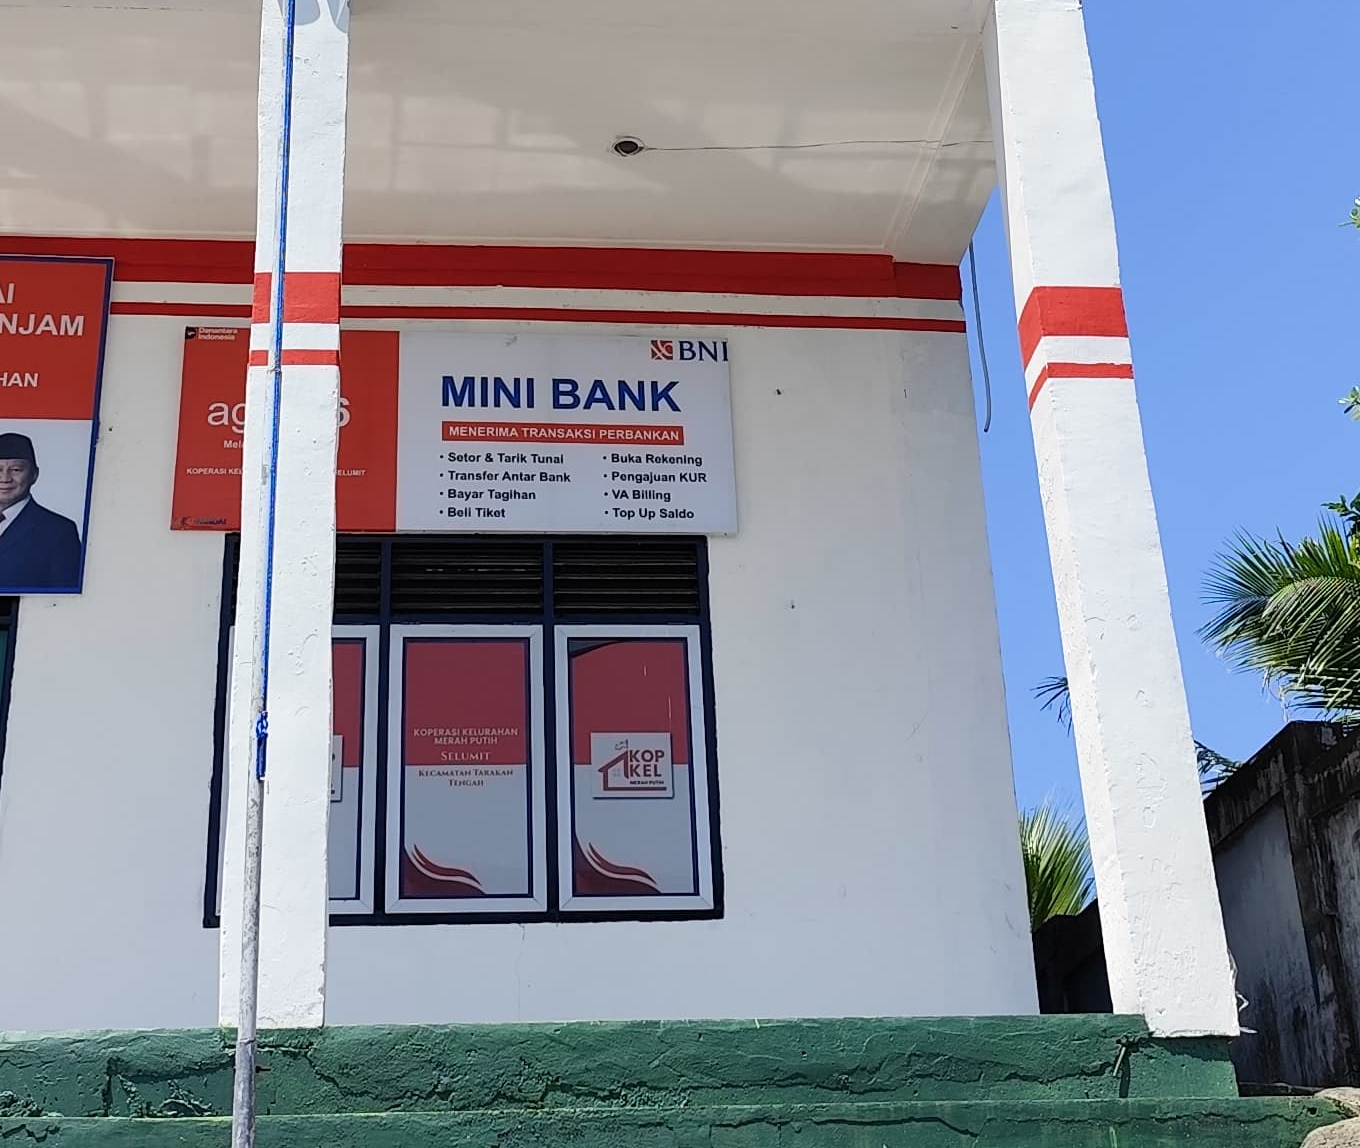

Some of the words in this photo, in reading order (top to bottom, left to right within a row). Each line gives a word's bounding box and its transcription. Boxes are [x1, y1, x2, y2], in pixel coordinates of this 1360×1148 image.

[678, 340, 728, 362] BNI
[440, 375, 535, 410] MINI
[551, 378, 681, 412] BANK
[449, 426, 518, 437] MENERIMA
[521, 427, 596, 439] TRANSAKSI
[599, 429, 680, 441] PERBANKAN
[447, 452, 481, 463] Setor
[484, 452, 494, 463] &
[497, 453, 527, 463] Tarik
[531, 453, 564, 464] Tunai
[611, 454, 642, 464] Buka
[645, 454, 703, 467] Rekening
[186, 467, 227, 475] KOPERASI
[336, 468, 367, 477] ELUMIT
[447, 470, 499, 481] Transfer
[502, 471, 536, 482] Antar
[540, 472, 571, 483] Bank
[612, 472, 676, 485] Pengajuan
[679, 472, 707, 483] KUR
[447, 489, 484, 502] Bayar
[488, 489, 537, 502] Tagihan
[612, 489, 629, 500] VA
[632, 489, 671, 502] Billing
[447, 507, 472, 518] Beli
[475, 507, 506, 518] Tiket
[612, 507, 636, 519] Top
[638, 508, 656, 520] Up
[659, 507, 695, 519] Saldo
[413, 728, 461, 737] KOPERASI
[462, 728, 518, 736] KELURAHAN
[434, 736, 468, 745] MERAH
[470, 736, 498, 745] PUTIH
[629, 749, 665, 763] KOP
[629, 763, 662, 778] KEL
